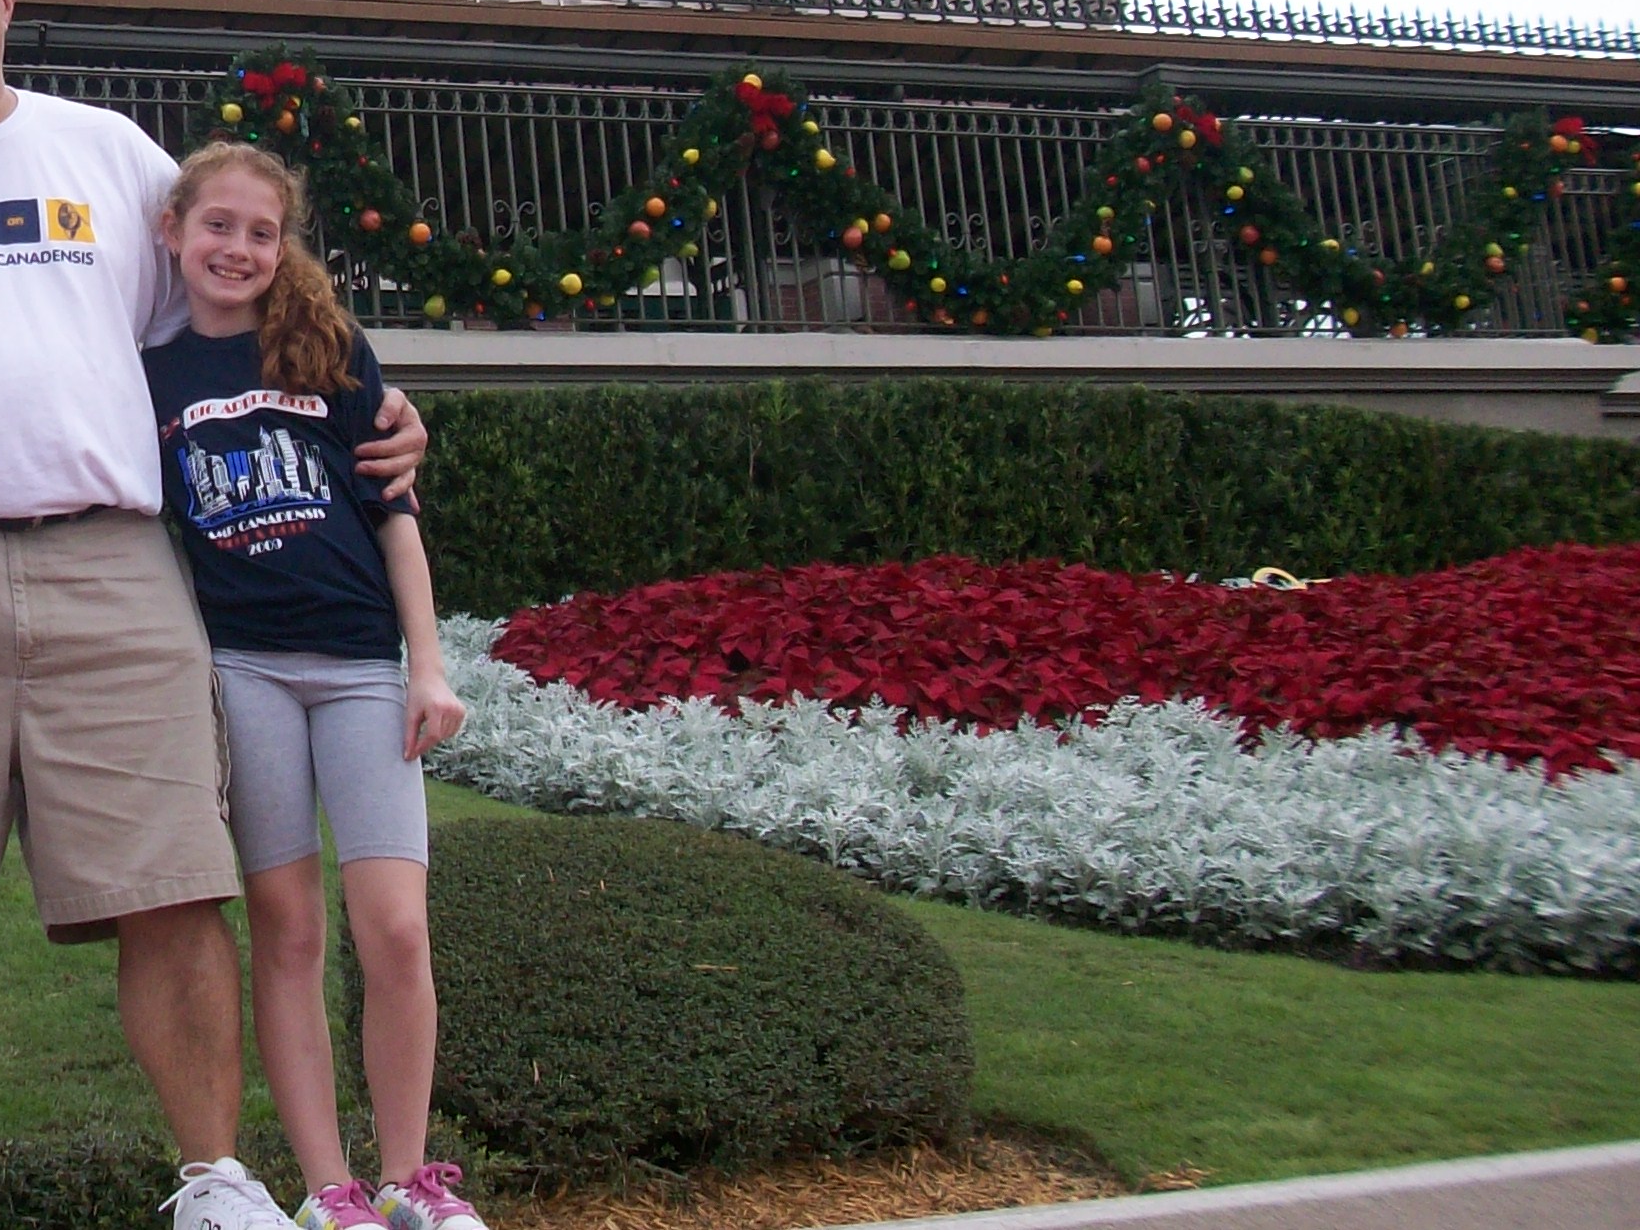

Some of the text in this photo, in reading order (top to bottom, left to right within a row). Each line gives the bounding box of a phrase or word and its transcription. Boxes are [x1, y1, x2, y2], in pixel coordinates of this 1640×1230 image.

[221, 392, 273, 414] APPLE
[204, 524, 236, 540] AMP
[238, 508, 327, 532] CANADENSIS
[247, 538, 283, 557] 2009
